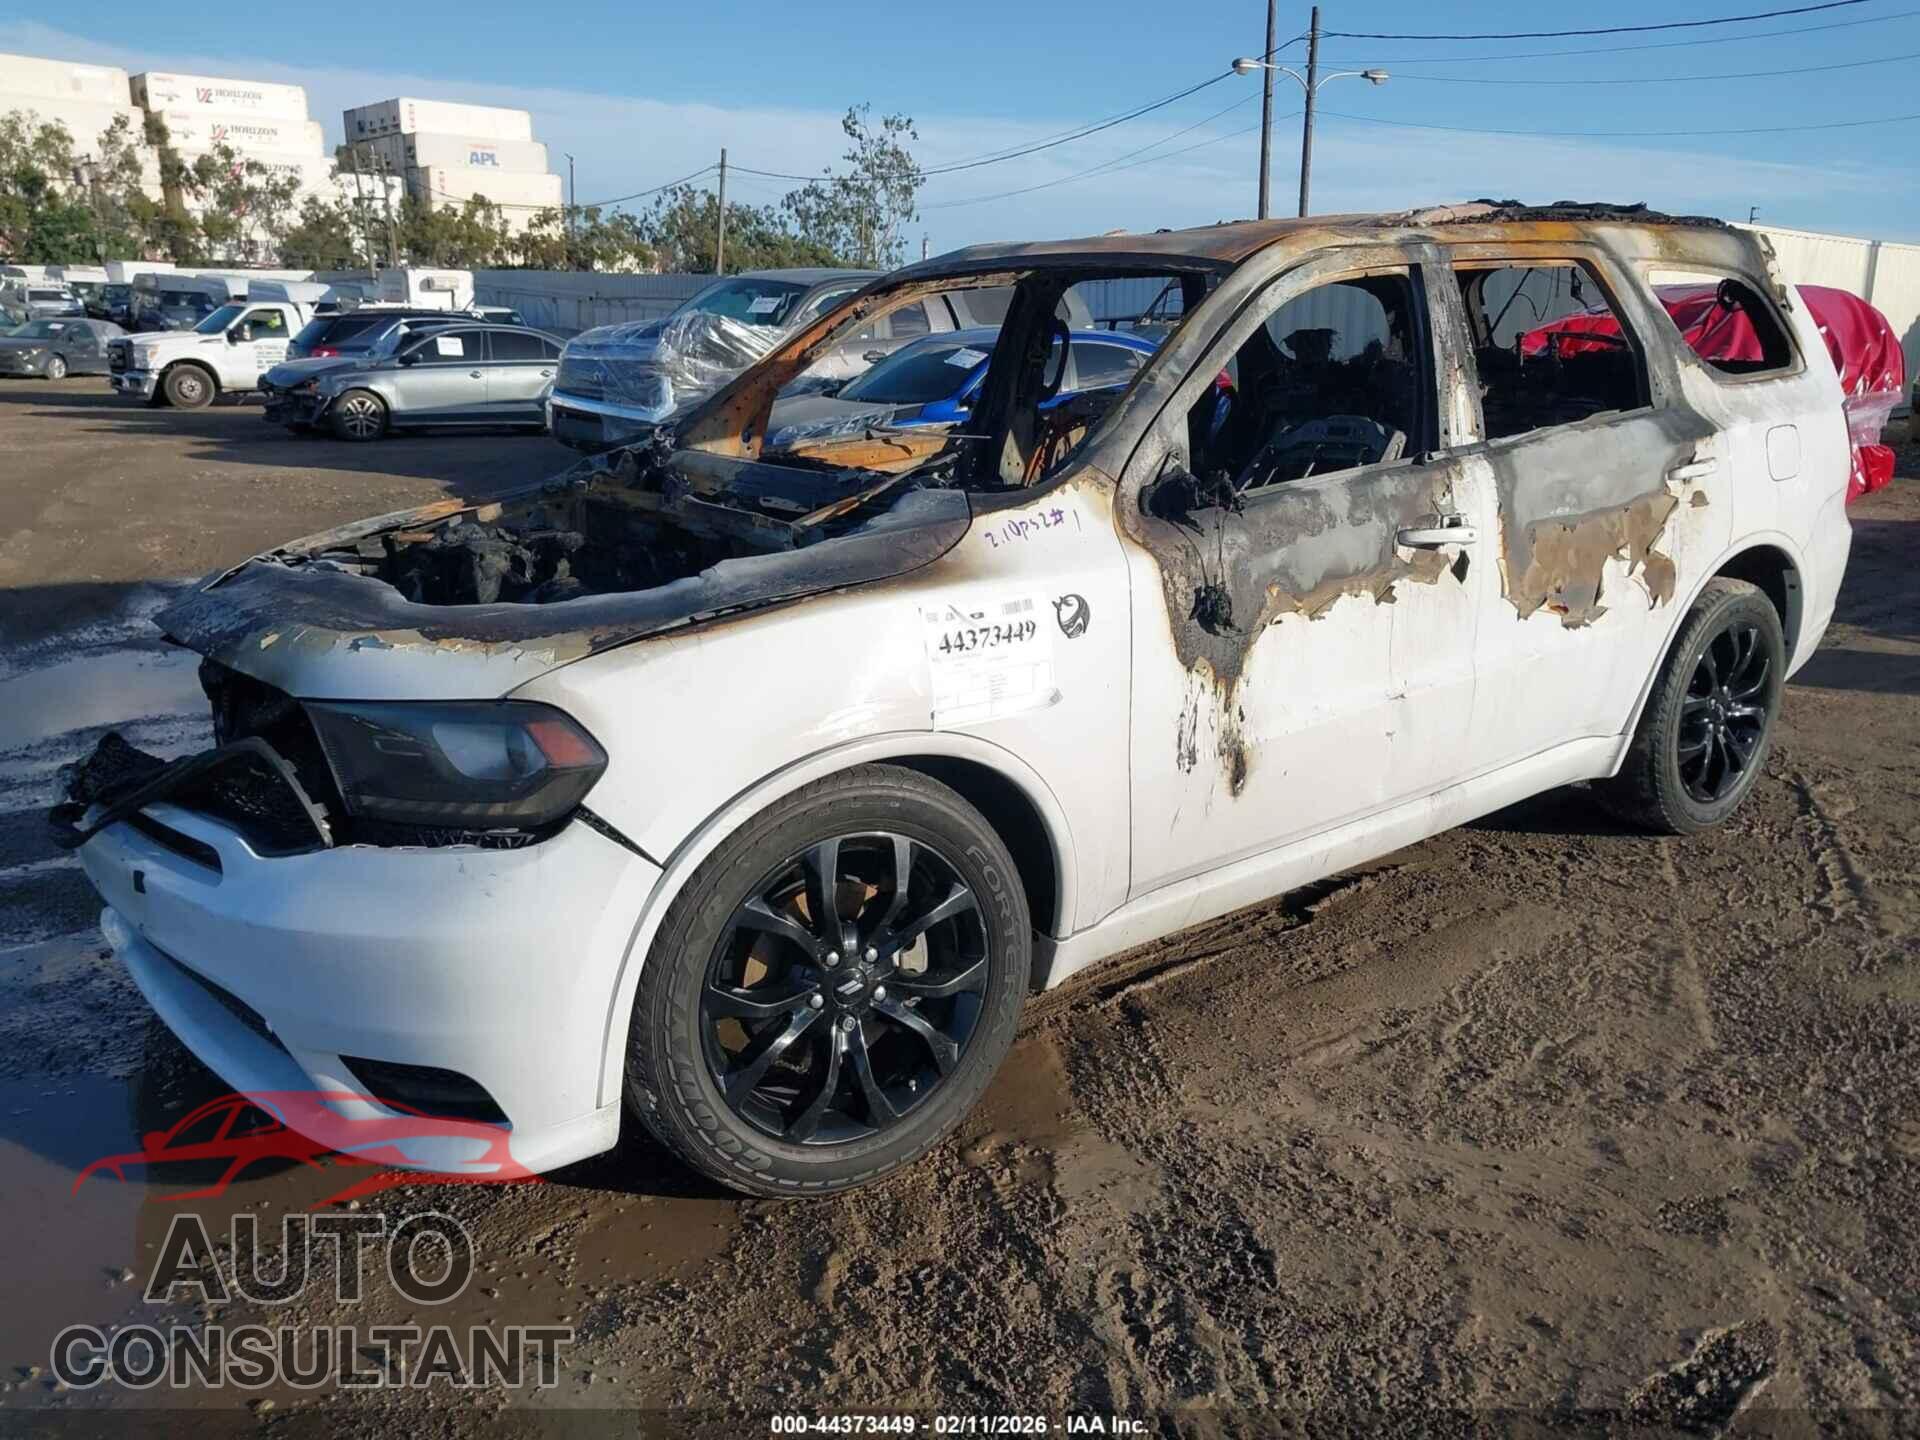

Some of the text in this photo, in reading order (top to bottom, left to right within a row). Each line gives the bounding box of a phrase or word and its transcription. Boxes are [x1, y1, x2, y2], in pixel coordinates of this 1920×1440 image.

[215, 89, 262, 100] HORIZON
[230, 124, 278, 136] HORIZON
[469, 151, 500, 166] APL
[939, 620, 1036, 654] 44373449
